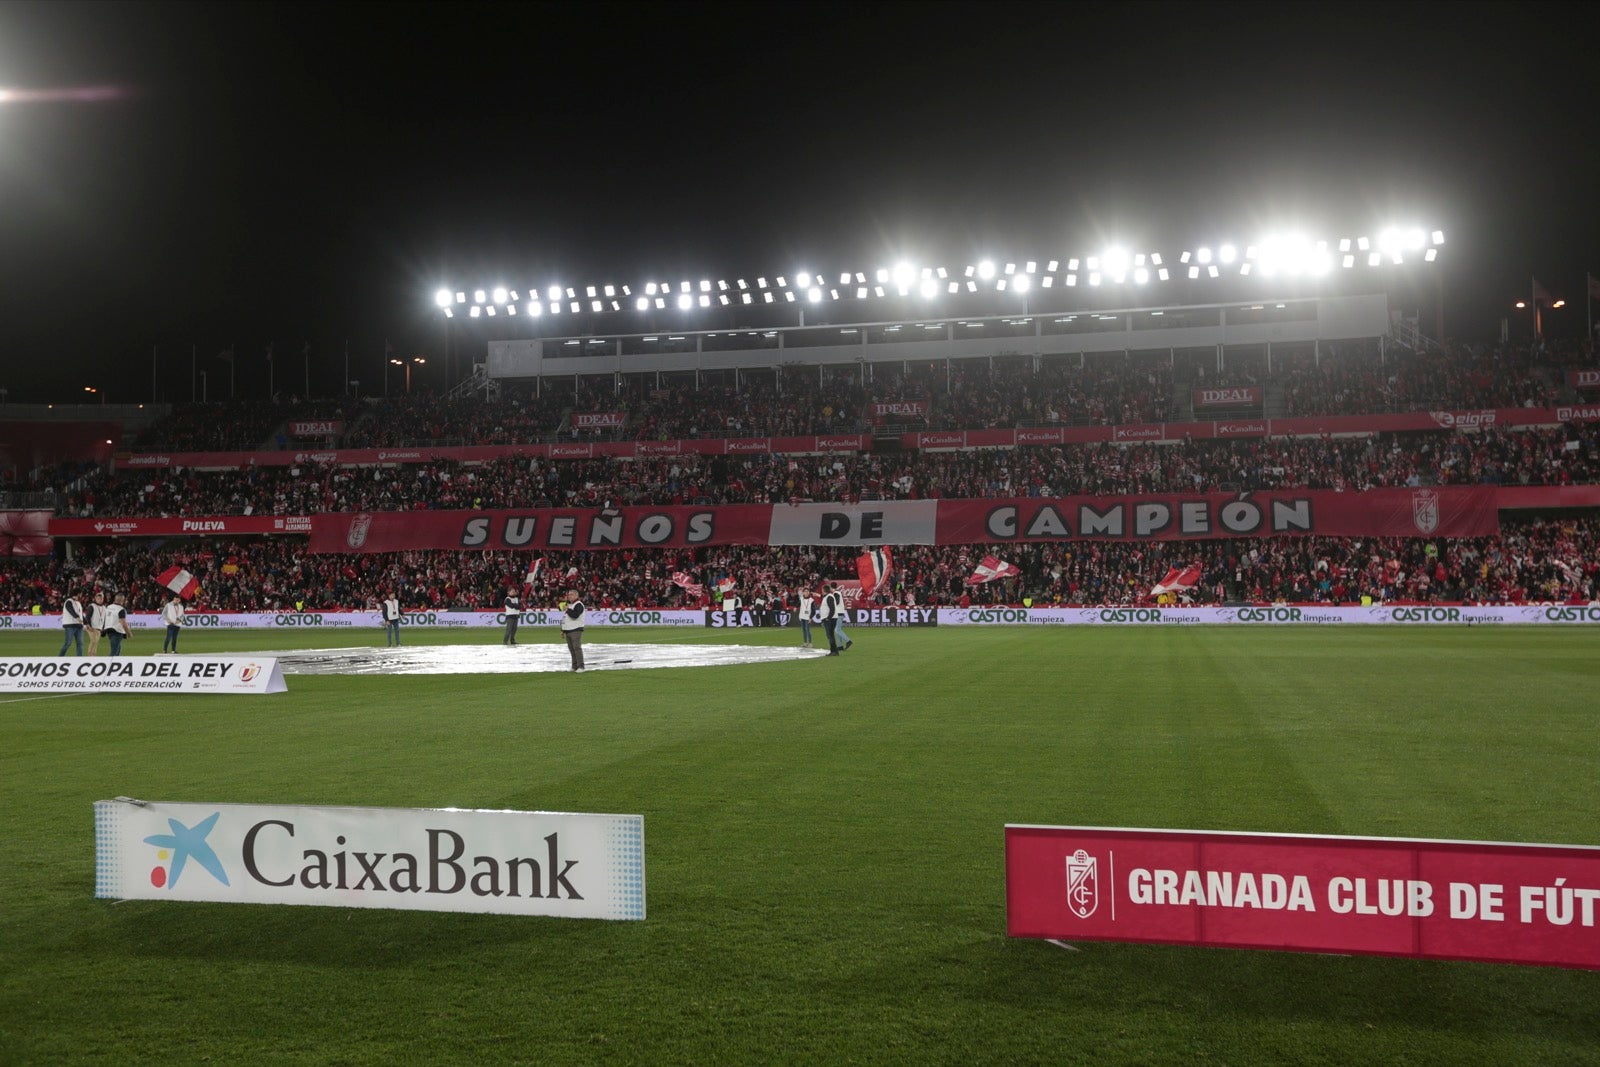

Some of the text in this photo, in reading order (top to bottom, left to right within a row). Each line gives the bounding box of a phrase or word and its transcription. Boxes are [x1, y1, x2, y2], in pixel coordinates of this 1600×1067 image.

[1577, 372, 1600, 384] ID
[1202, 389, 1252, 401] IDEAL
[877, 403, 921, 414] IDEAL
[1573, 409, 1600, 418] ABA
[578, 414, 620, 425] IDEAL
[157, 456, 170, 465] Hoy
[183, 521, 225, 530] PULEVA
[461, 492, 1314, 548] SUEÑOS DE CAMPEÓN
[275, 614, 351, 627] CASTOR limpieza
[496, 612, 547, 625] CTOR
[609, 611, 694, 625] CASTOR limpieza
[857, 609, 890, 622] DEL
[897, 608, 932, 622] REY
[969, 609, 1064, 624] CASTOR limpieza
[1099, 608, 1200, 623] CASTOR limpieza
[1237, 607, 1342, 623] CASTOR limpieza
[1391, 607, 1503, 623] CASTOR limpieza
[13, 621, 40, 629] limpieza
[220, 620, 247, 628] limpieza
[438, 618, 467, 627] limpieza
[0, 662, 234, 677] SOMOS COPA DEL REY
[51, 679, 86, 688] FÚTBOL
[123, 679, 182, 689] FEDERACIÓN
[241, 819, 585, 900] CaixaBank
[1128, 868, 1600, 927] GRANADA CLUB DE FÚT
